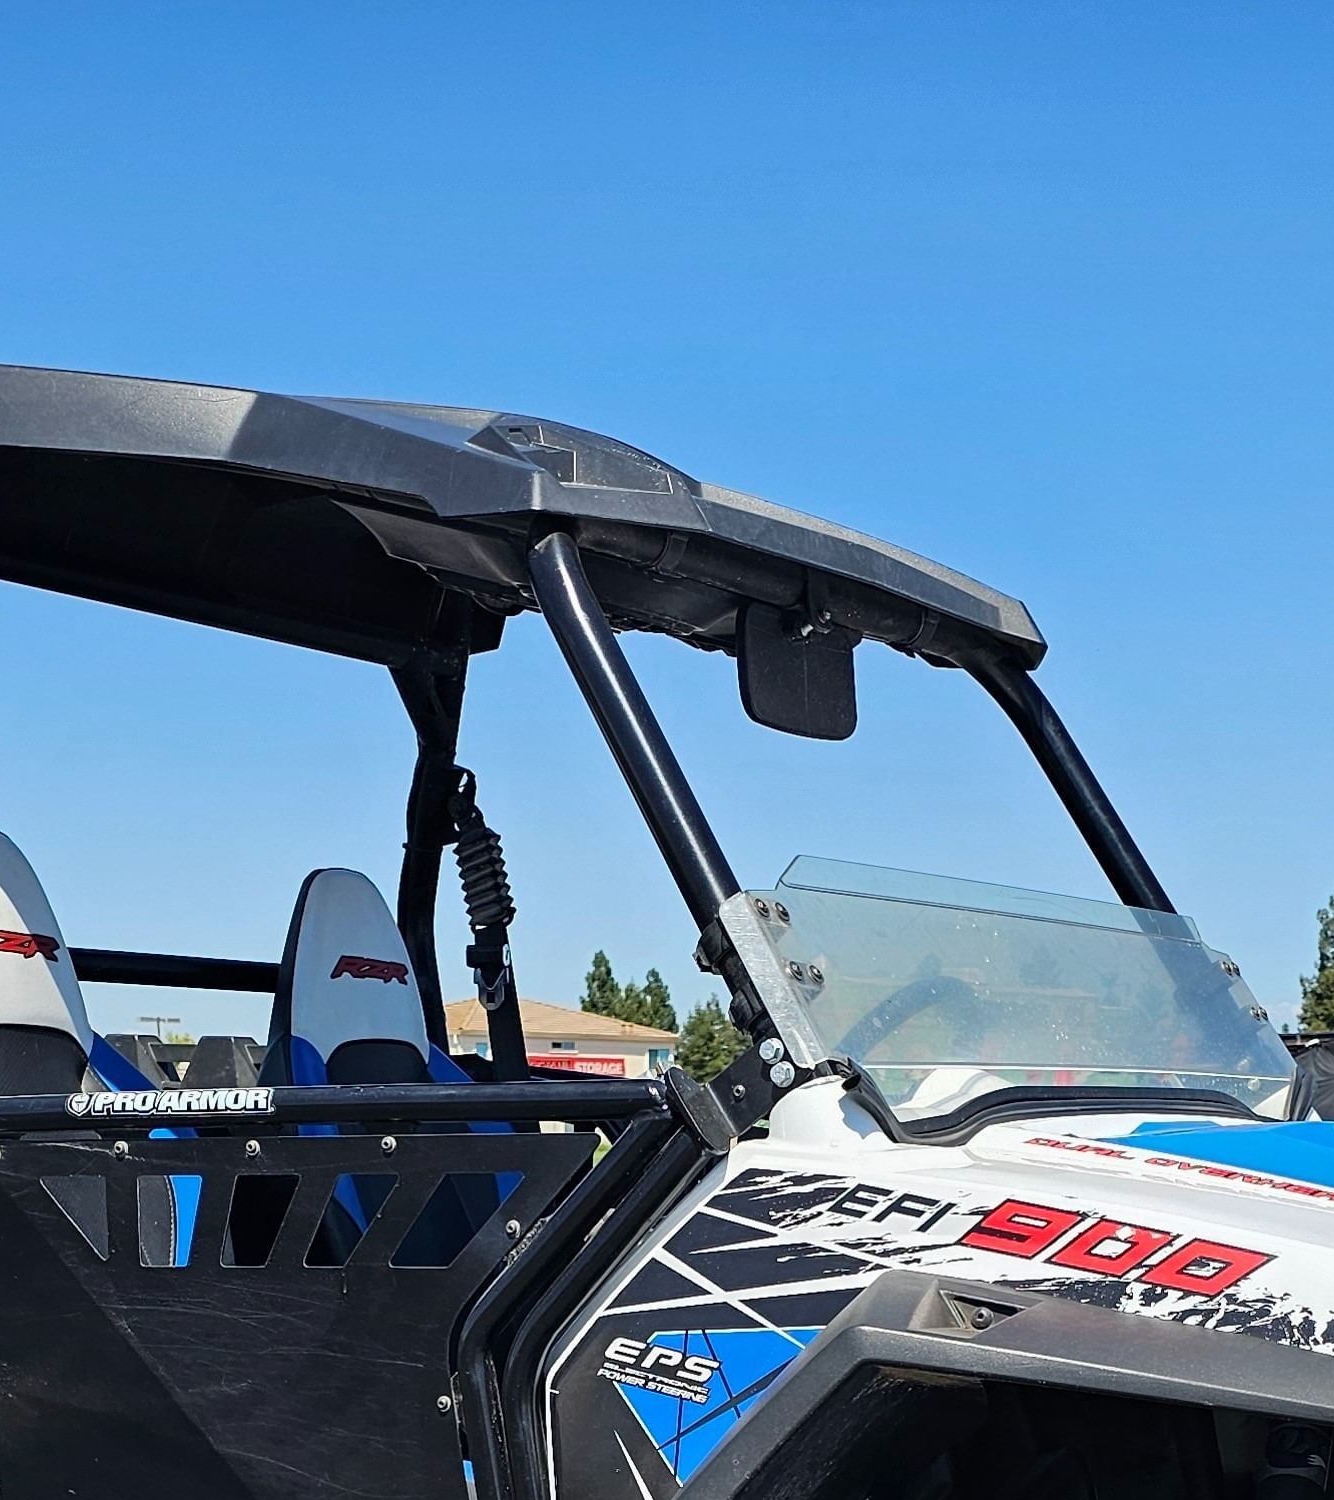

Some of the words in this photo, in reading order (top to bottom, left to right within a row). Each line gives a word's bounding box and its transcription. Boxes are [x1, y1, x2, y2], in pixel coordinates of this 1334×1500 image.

[330, 955, 409, 986] RZR
[574, 1060, 624, 1076] STORAGE
[94, 1091, 157, 1112] PRO
[157, 1089, 268, 1112] ARMOR
[1023, 1137, 1135, 1160] DUAL
[826, 1183, 957, 1233] EFI
[957, 1198, 1278, 1297] 900
[604, 1337, 720, 1383] EPS
[597, 1368, 646, 1388] POWER
[646, 1381, 708, 1404] STEERING
[603, 1362, 709, 1394] ELECTRONIC
